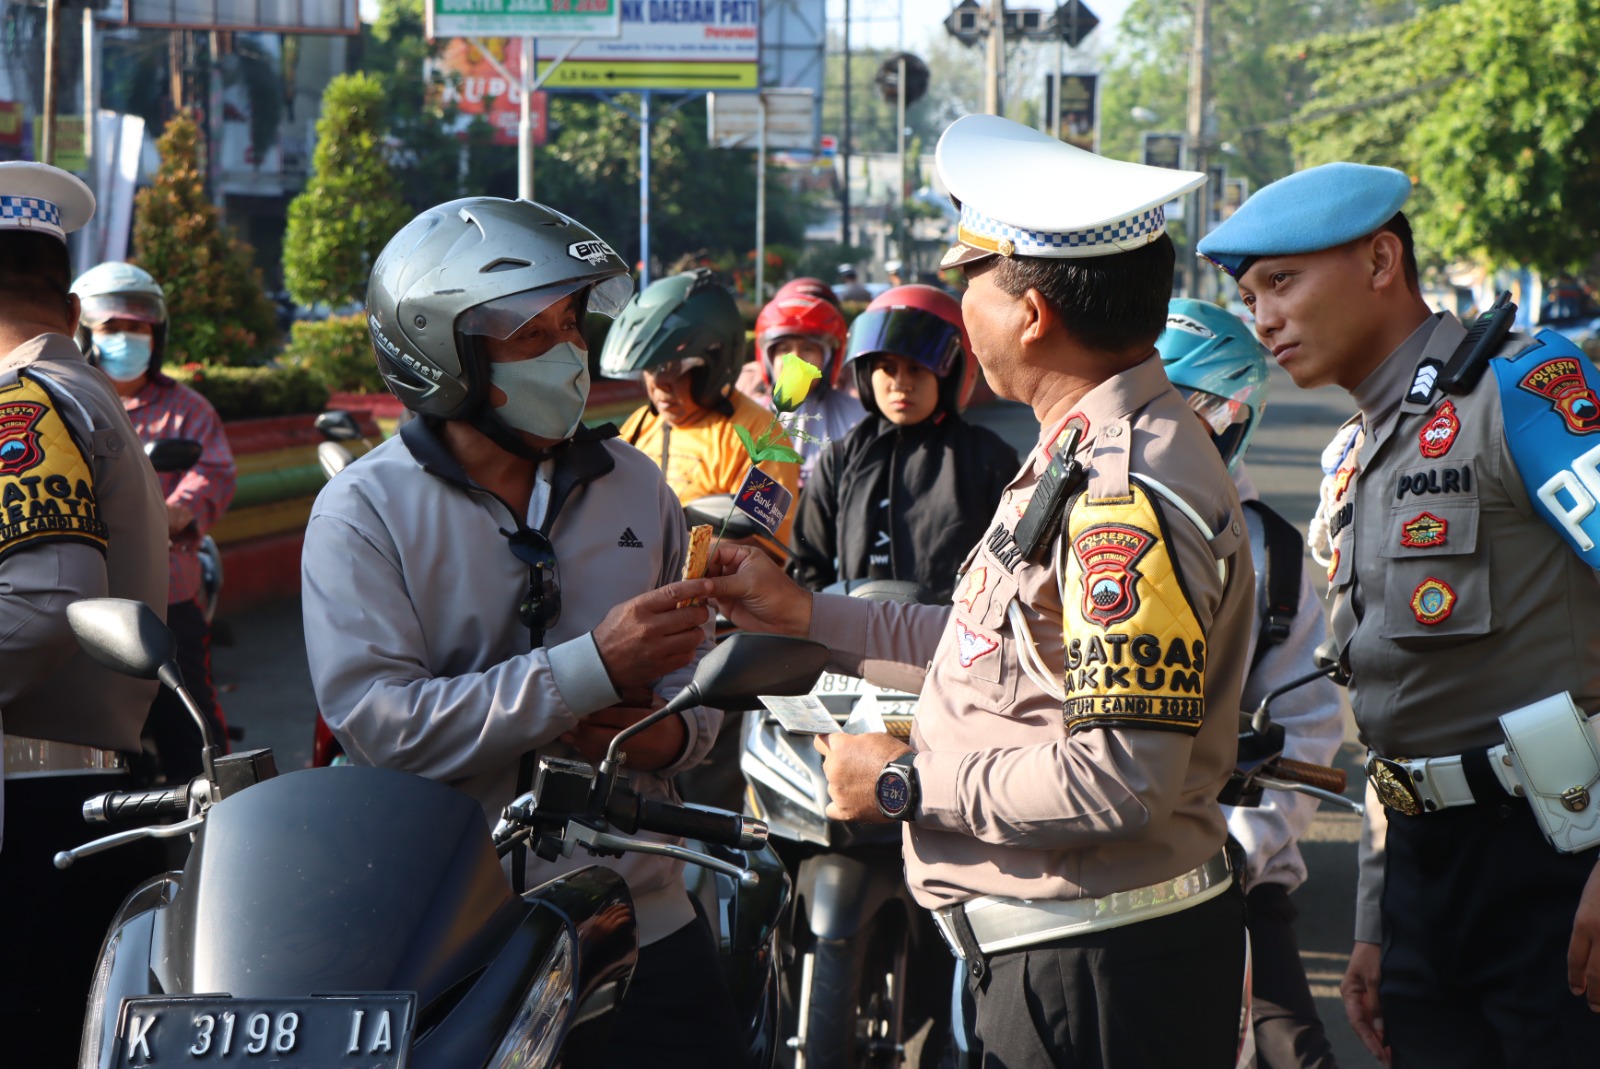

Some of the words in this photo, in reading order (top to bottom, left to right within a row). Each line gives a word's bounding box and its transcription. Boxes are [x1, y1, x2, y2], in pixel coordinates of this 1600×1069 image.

[650, 0, 715, 23] DAERAH
[720, 0, 756, 24] PATI
[1167, 317, 1209, 333] NK
[1528, 361, 1576, 386] POLRESTA
[3, 474, 96, 508] ATGA
[1396, 465, 1471, 499] POLRI
[753, 491, 771, 510] Bank
[26, 515, 73, 531] CANDI
[617, 540, 644, 548] adidas
[1078, 532, 1140, 549] POLRESTA
[1089, 538, 1127, 549] PATI
[1101, 697, 1153, 715] CANDI
[1159, 698, 1199, 717] 2023
[128, 1015, 157, 1059] K
[191, 1010, 299, 1056] 3198
[348, 1009, 393, 1052] IA
